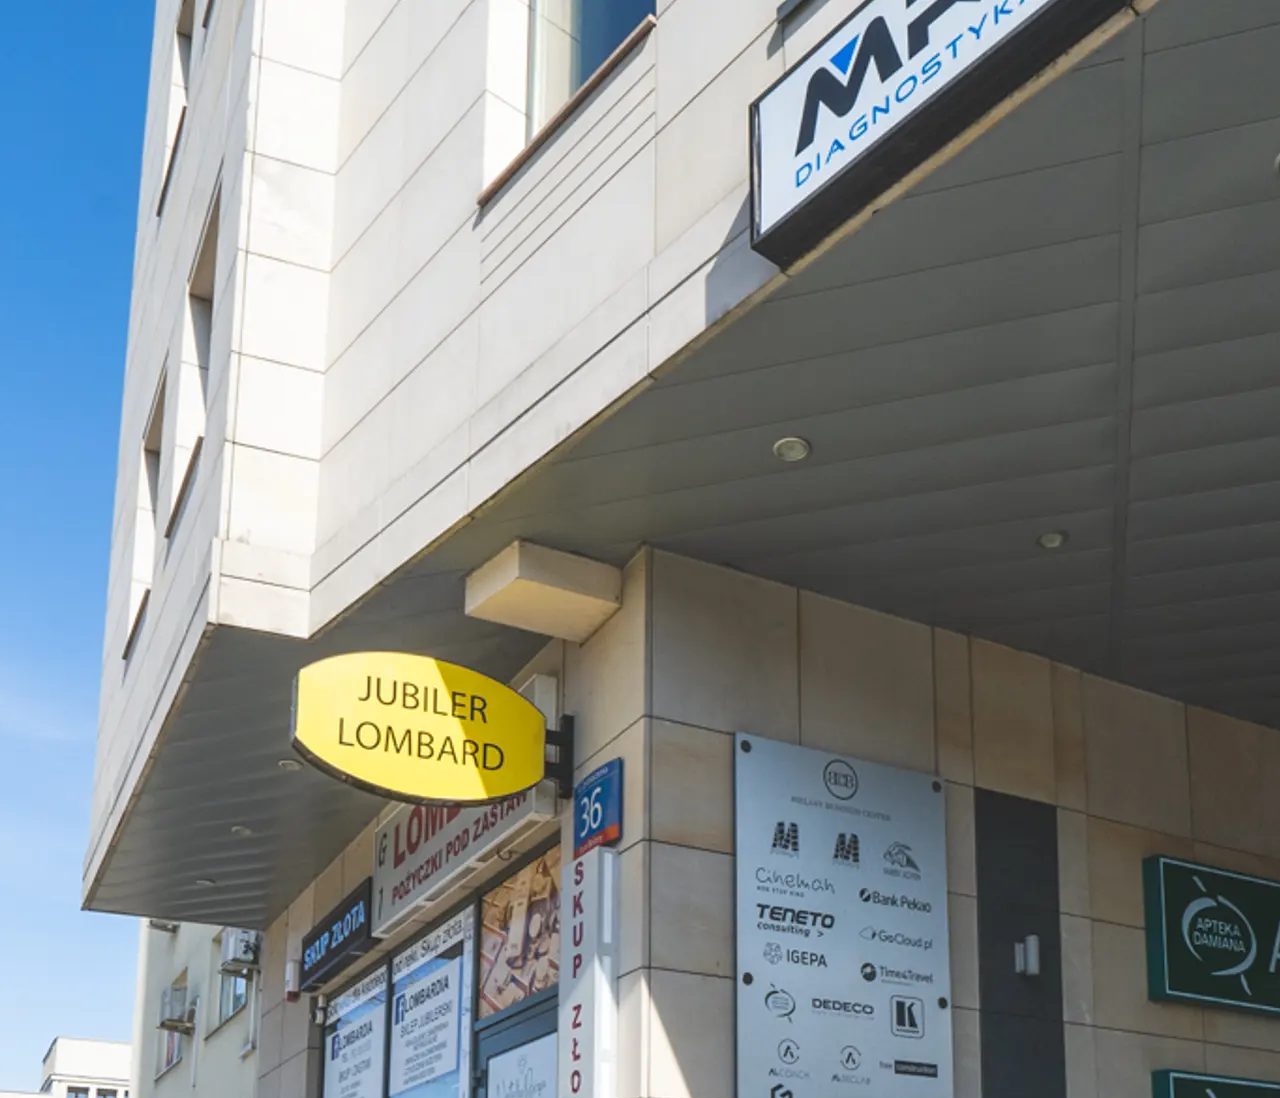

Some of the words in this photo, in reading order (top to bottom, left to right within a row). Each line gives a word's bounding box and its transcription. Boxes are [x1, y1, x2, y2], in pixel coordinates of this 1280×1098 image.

[794, 0, 1027, 188] DIAGNOSTYK
[358, 675, 488, 724] JUBILER
[337, 717, 505, 772] LOMBARD
[580, 786, 602, 838] 36
[446, 828, 470, 864] POD
[756, 903, 835, 929] TENETO
[872, 890, 899, 907] Bank
[900, 894, 932, 913] Pekao
[573, 861, 585, 979] SKUP
[757, 921, 811, 938] consulting
[1195, 917, 1242, 938] APTEKA
[303, 930, 329, 972] SKUP
[330, 900, 365, 950] ZŁOTA
[1193, 931, 1247, 953] DAMIANA
[786, 949, 828, 968] IGEPA
[811, 997, 875, 1016] DEDECO
